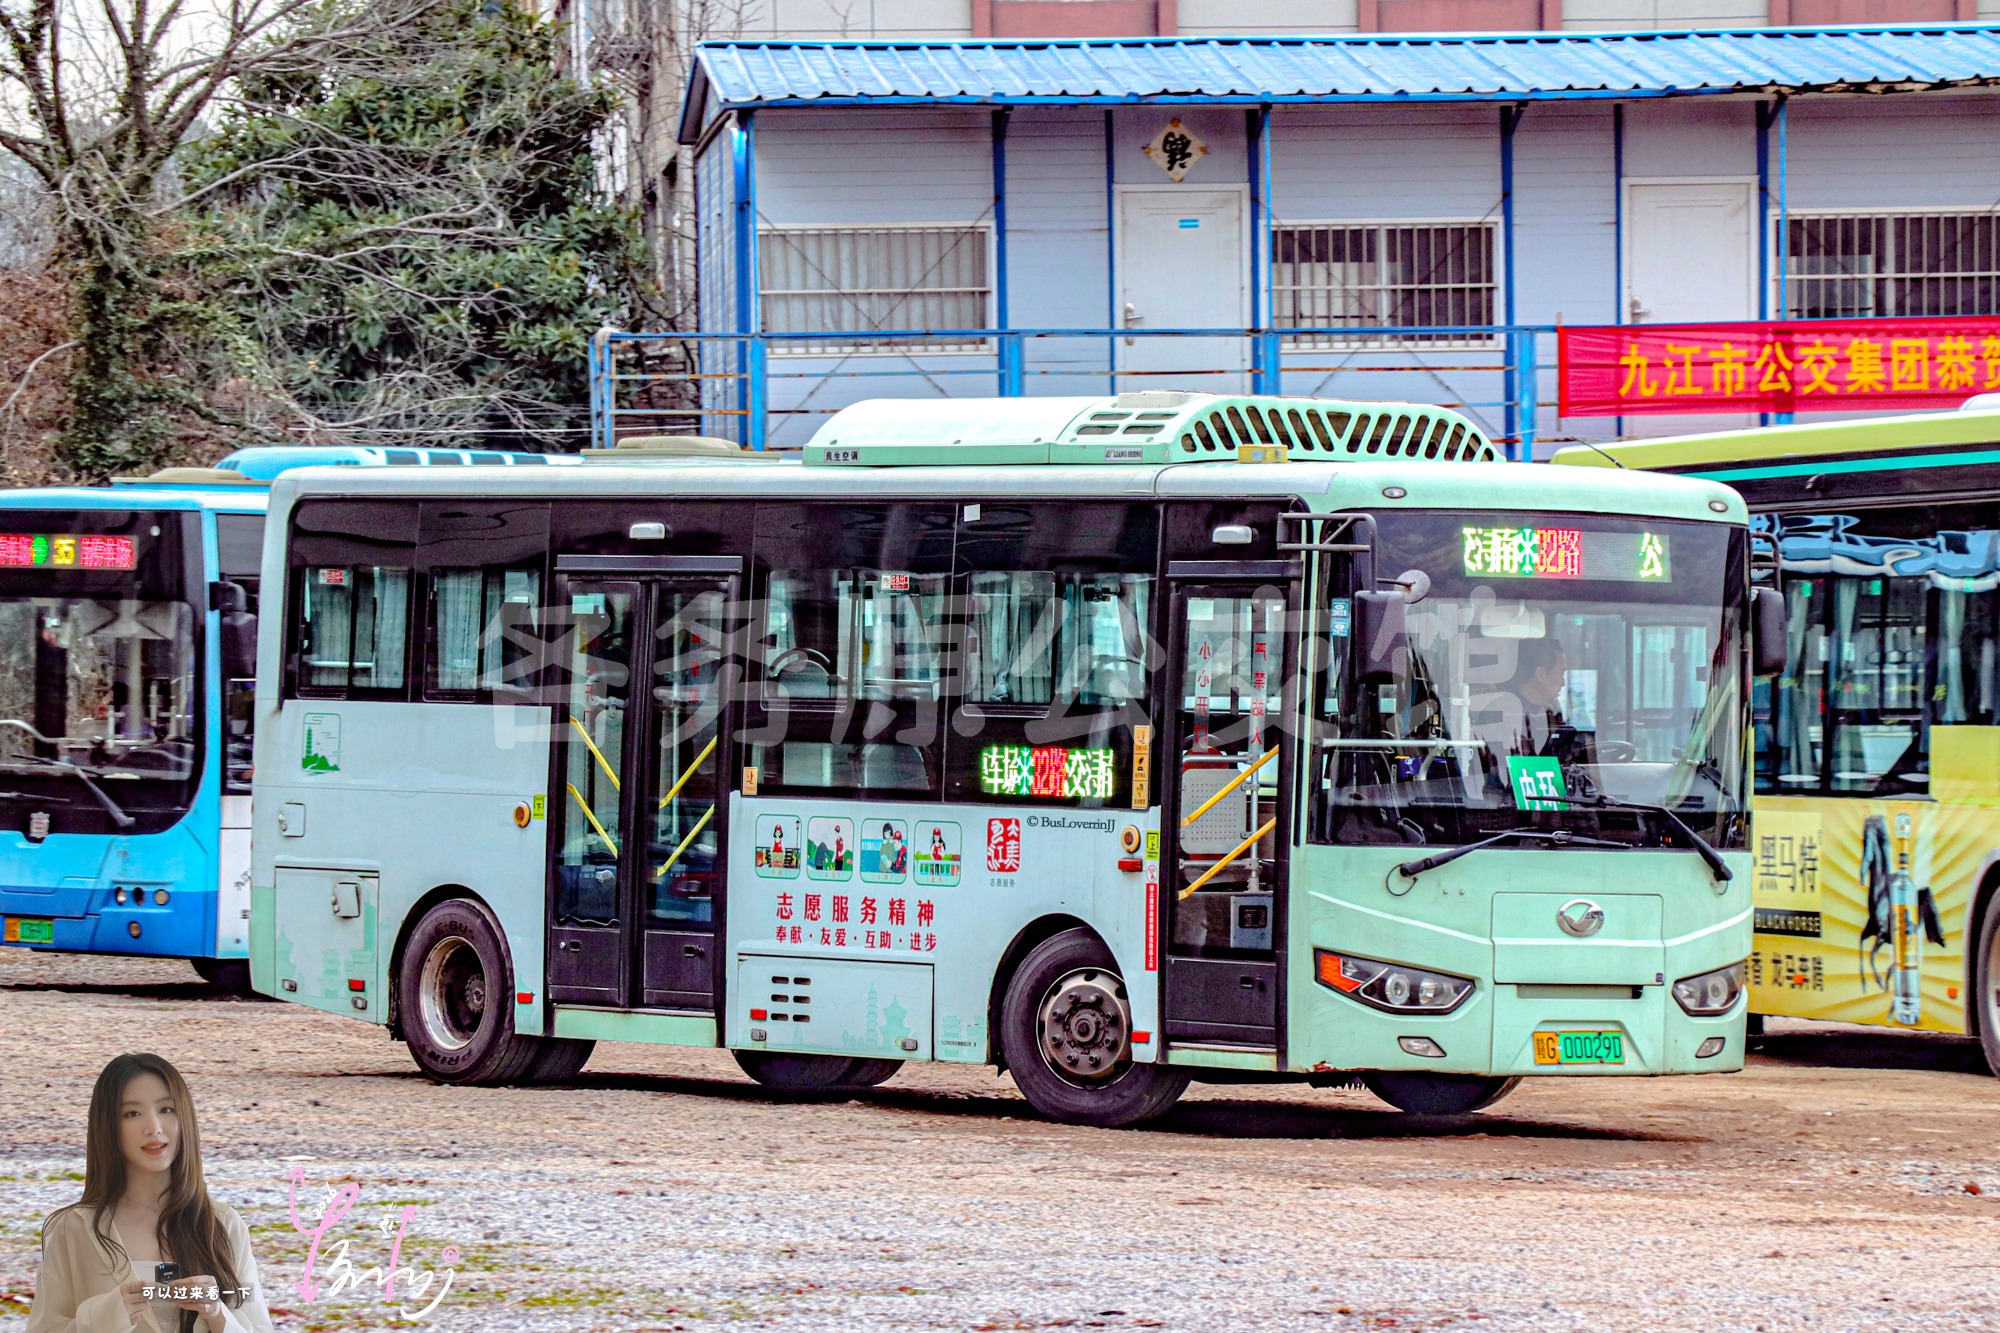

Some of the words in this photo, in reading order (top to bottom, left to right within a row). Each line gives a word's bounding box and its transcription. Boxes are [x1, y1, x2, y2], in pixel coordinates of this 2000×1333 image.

[825, 450, 859, 462] 良生空调
[1518, 768, 1559, 811] 内环
[775, 892, 935, 928] 志愿服务精神
